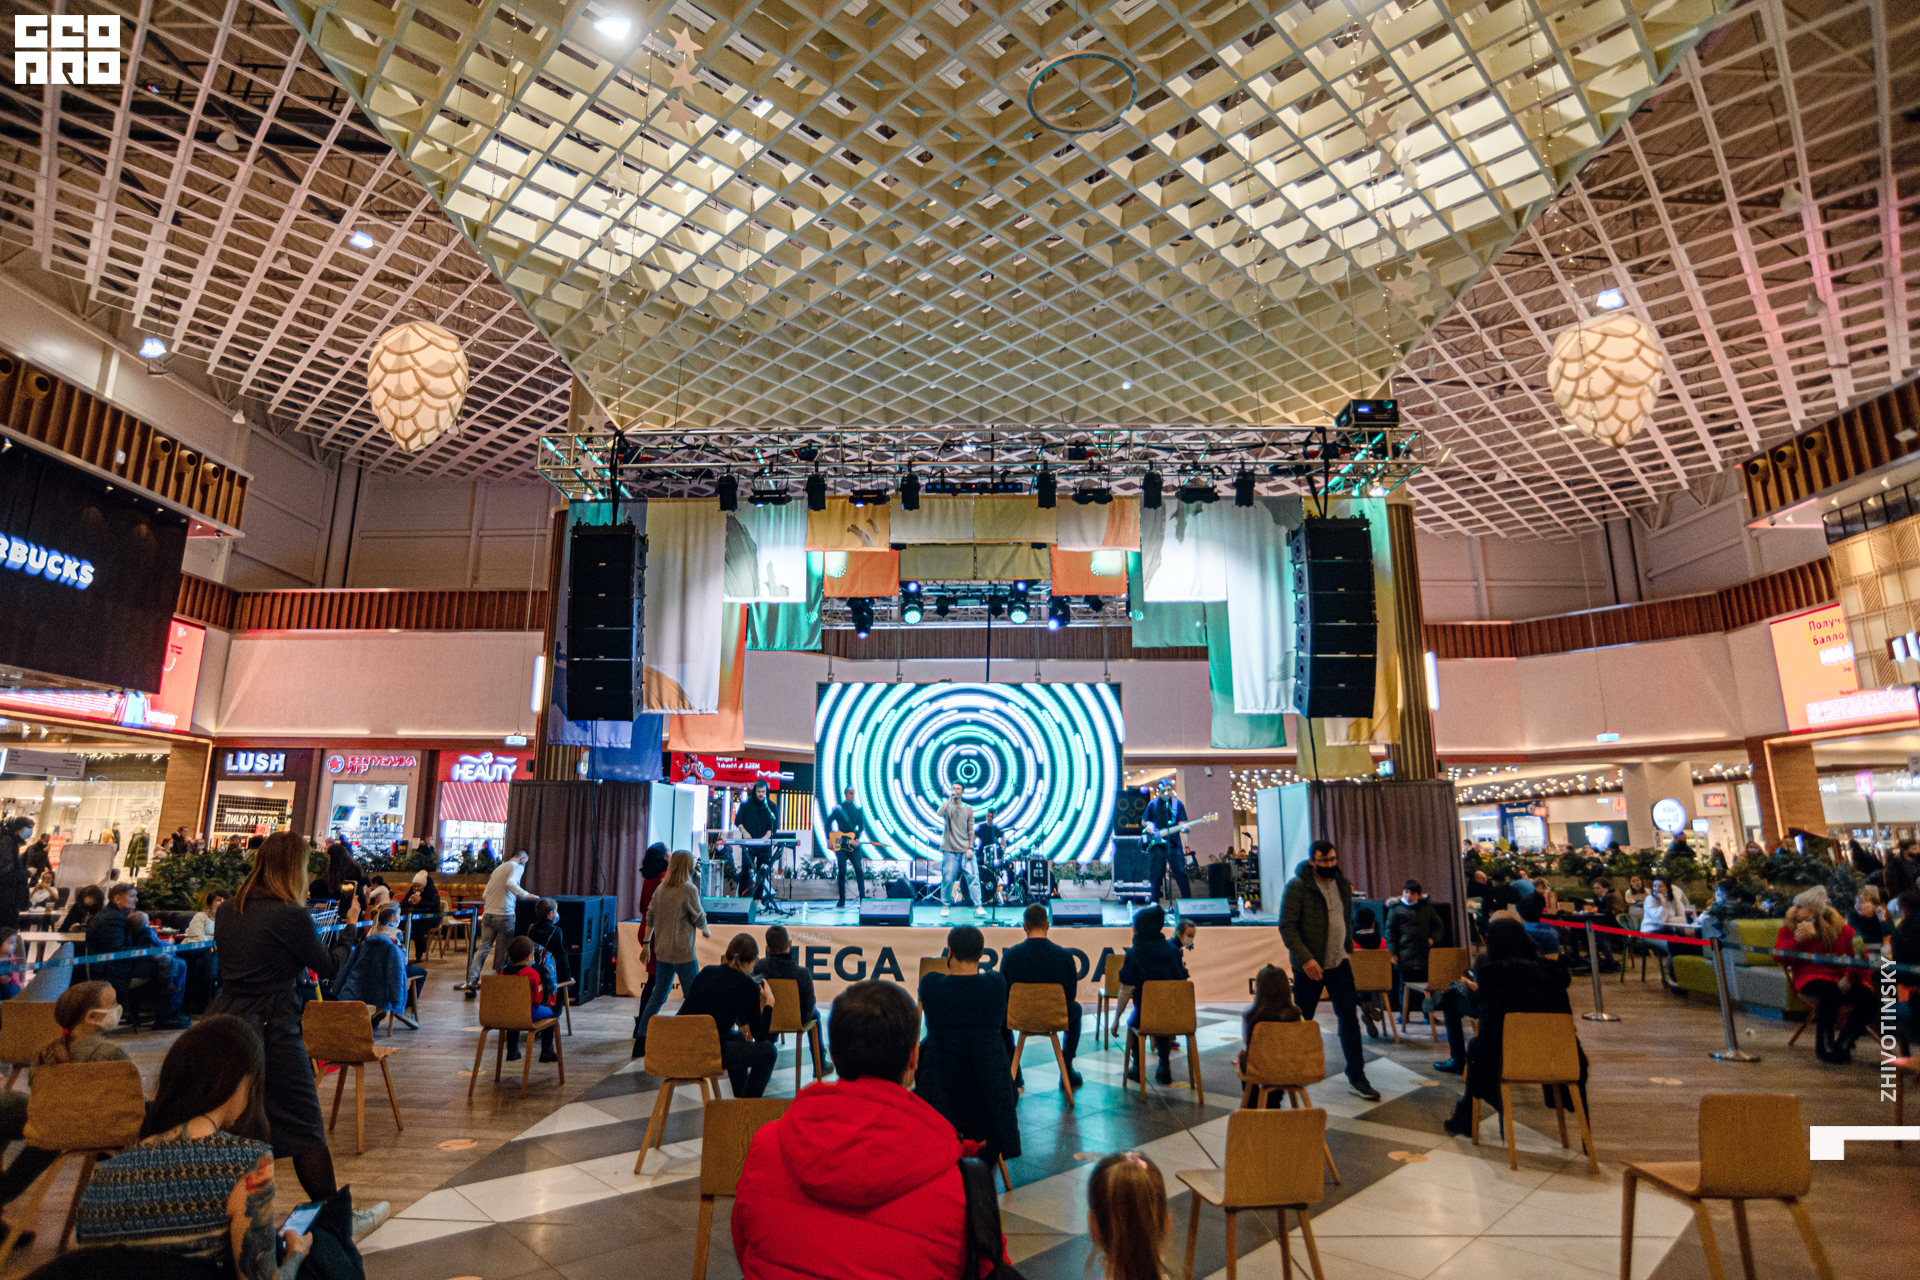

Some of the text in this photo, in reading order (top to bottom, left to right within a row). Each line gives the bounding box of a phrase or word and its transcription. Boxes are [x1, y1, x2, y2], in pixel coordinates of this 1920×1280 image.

[225, 752, 286, 772] LUSH
[345, 755, 416, 767] РЕСПУБЛИКА
[344, 763, 368, 773] ИГР
[757, 769, 795, 780] MAC
[223, 814, 249, 826] ЛИЦО
